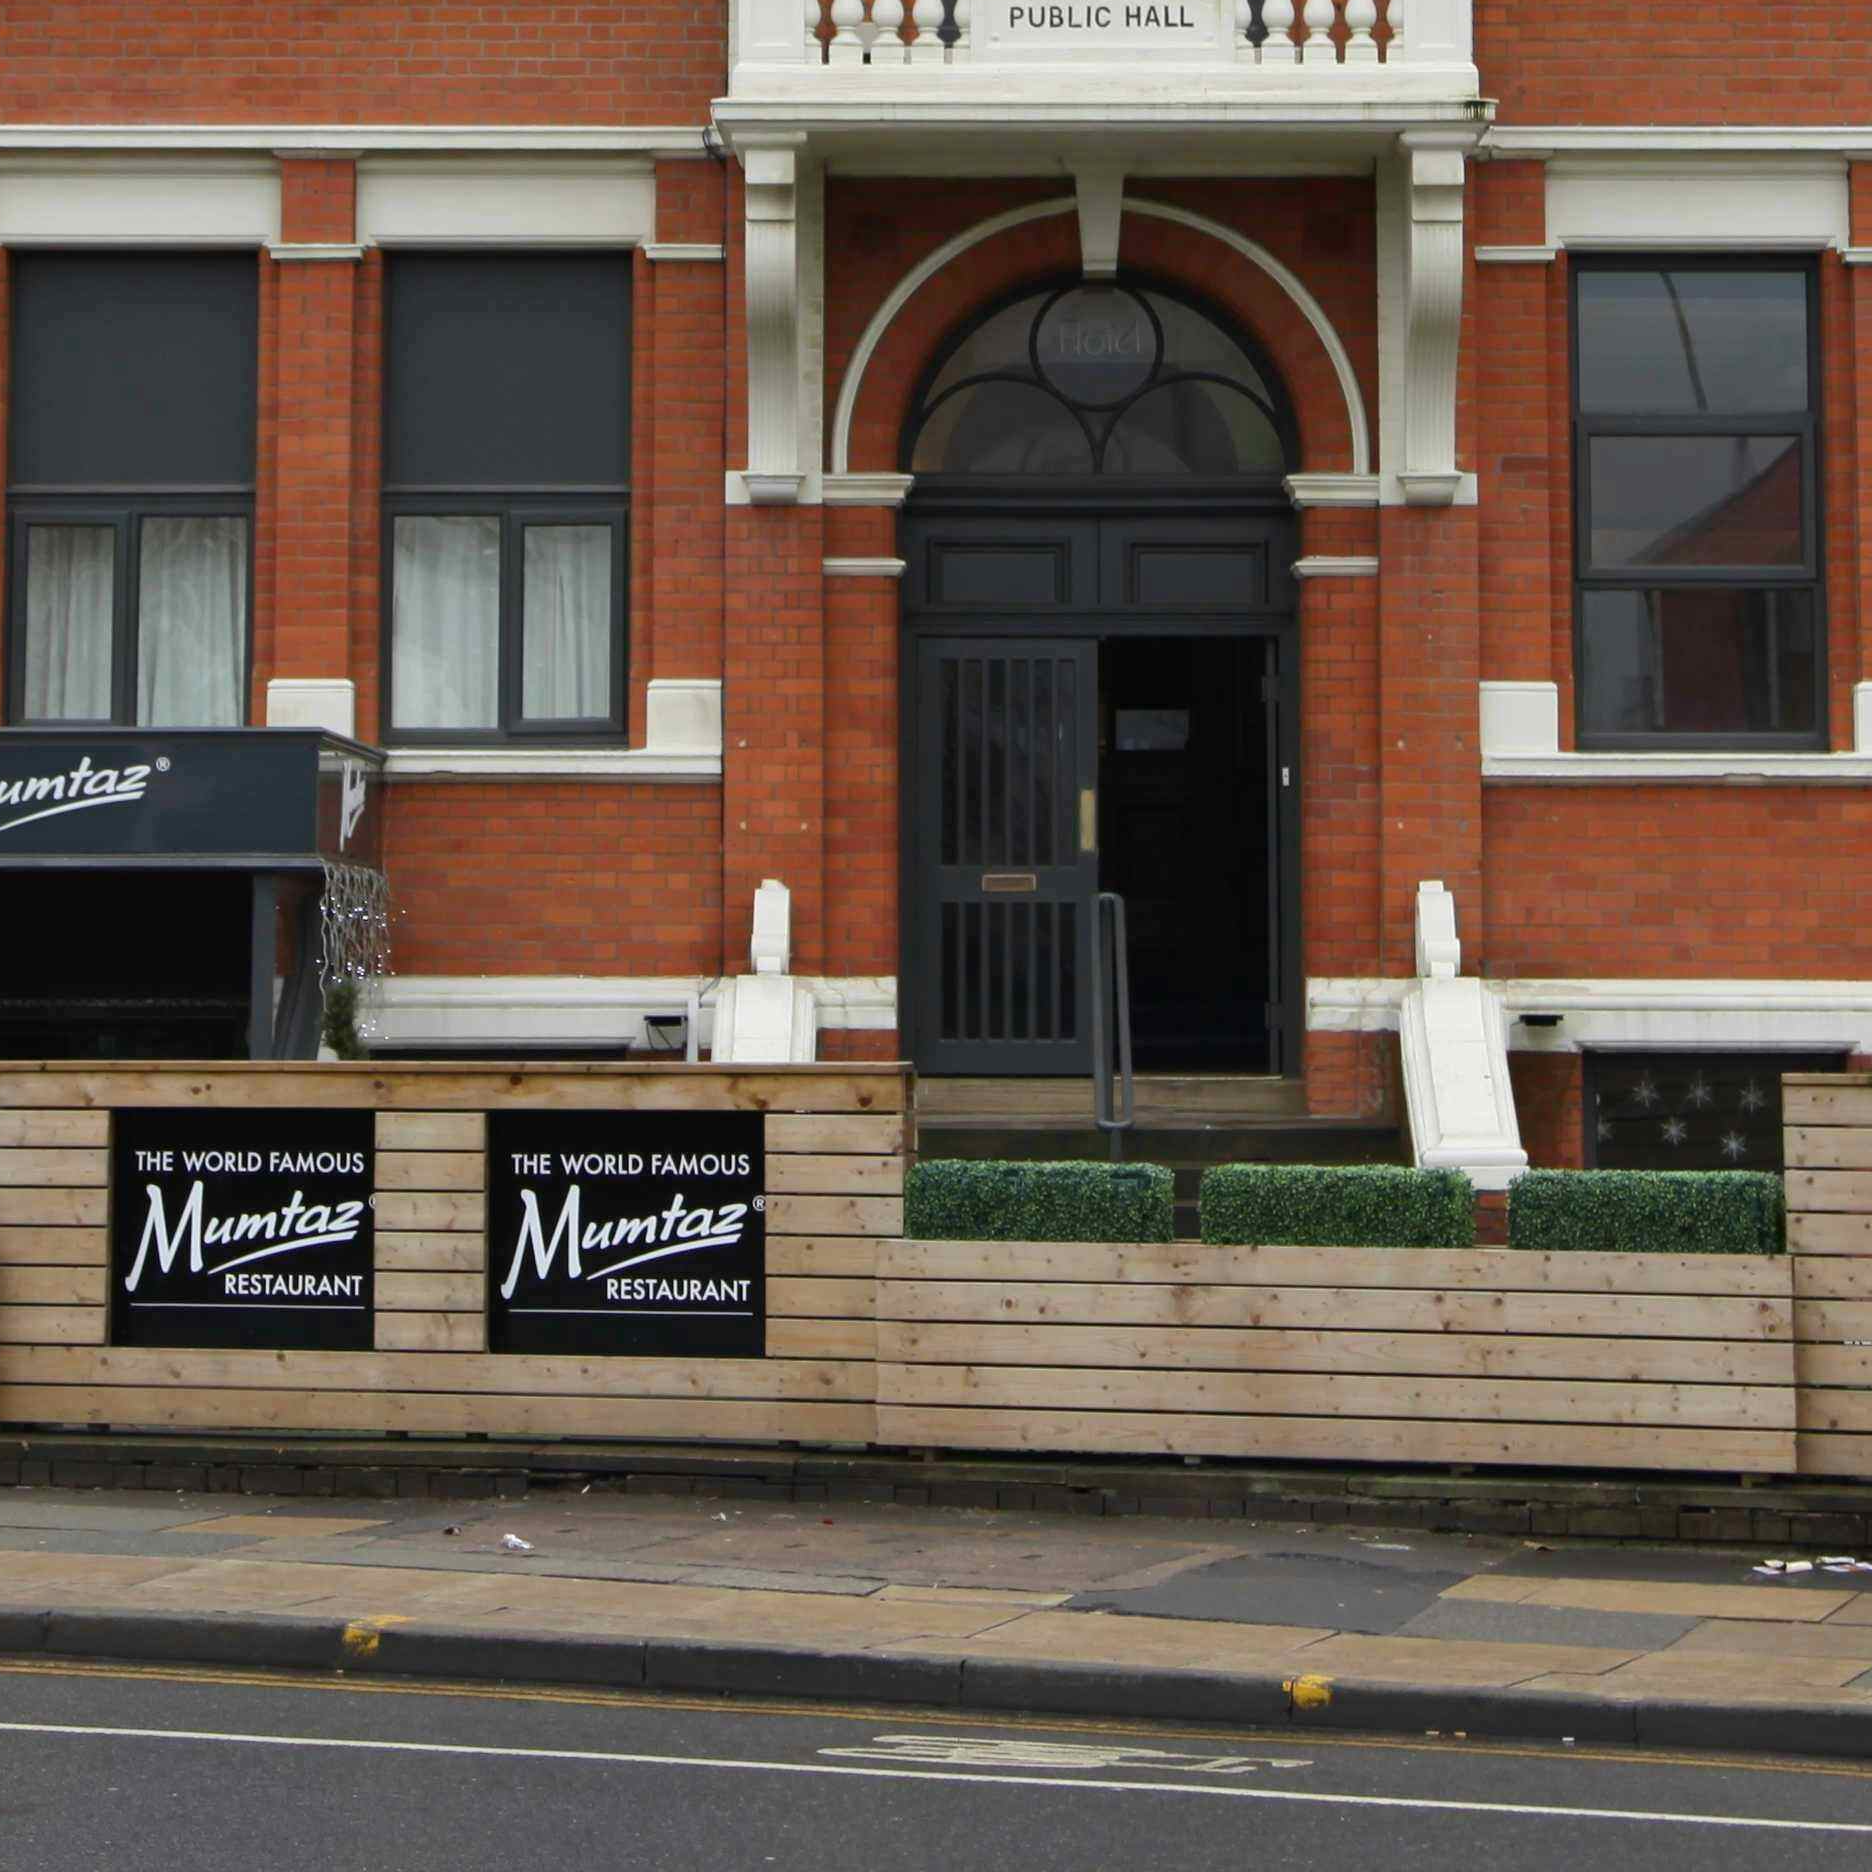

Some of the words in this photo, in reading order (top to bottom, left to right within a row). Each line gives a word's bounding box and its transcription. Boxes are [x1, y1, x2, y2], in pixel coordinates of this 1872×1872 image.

[1009, 6, 1111, 28] PUBLIC
[1125, 6, 1194, 28] HALL
[135, 1151, 174, 1171] THE
[182, 1151, 262, 1172] WORLD
[269, 1152, 365, 1173] FAMOUS
[511, 1154, 551, 1174] THE
[560, 1154, 643, 1175] WORLD
[651, 1154, 751, 1176] FAMOUS
[125, 1180, 364, 1292] Mumtaz
[500, 1184, 747, 1299] Mumtaz
[224, 1274, 363, 1296] RESTAURANT
[606, 1279, 751, 1301] RESTAURANT
